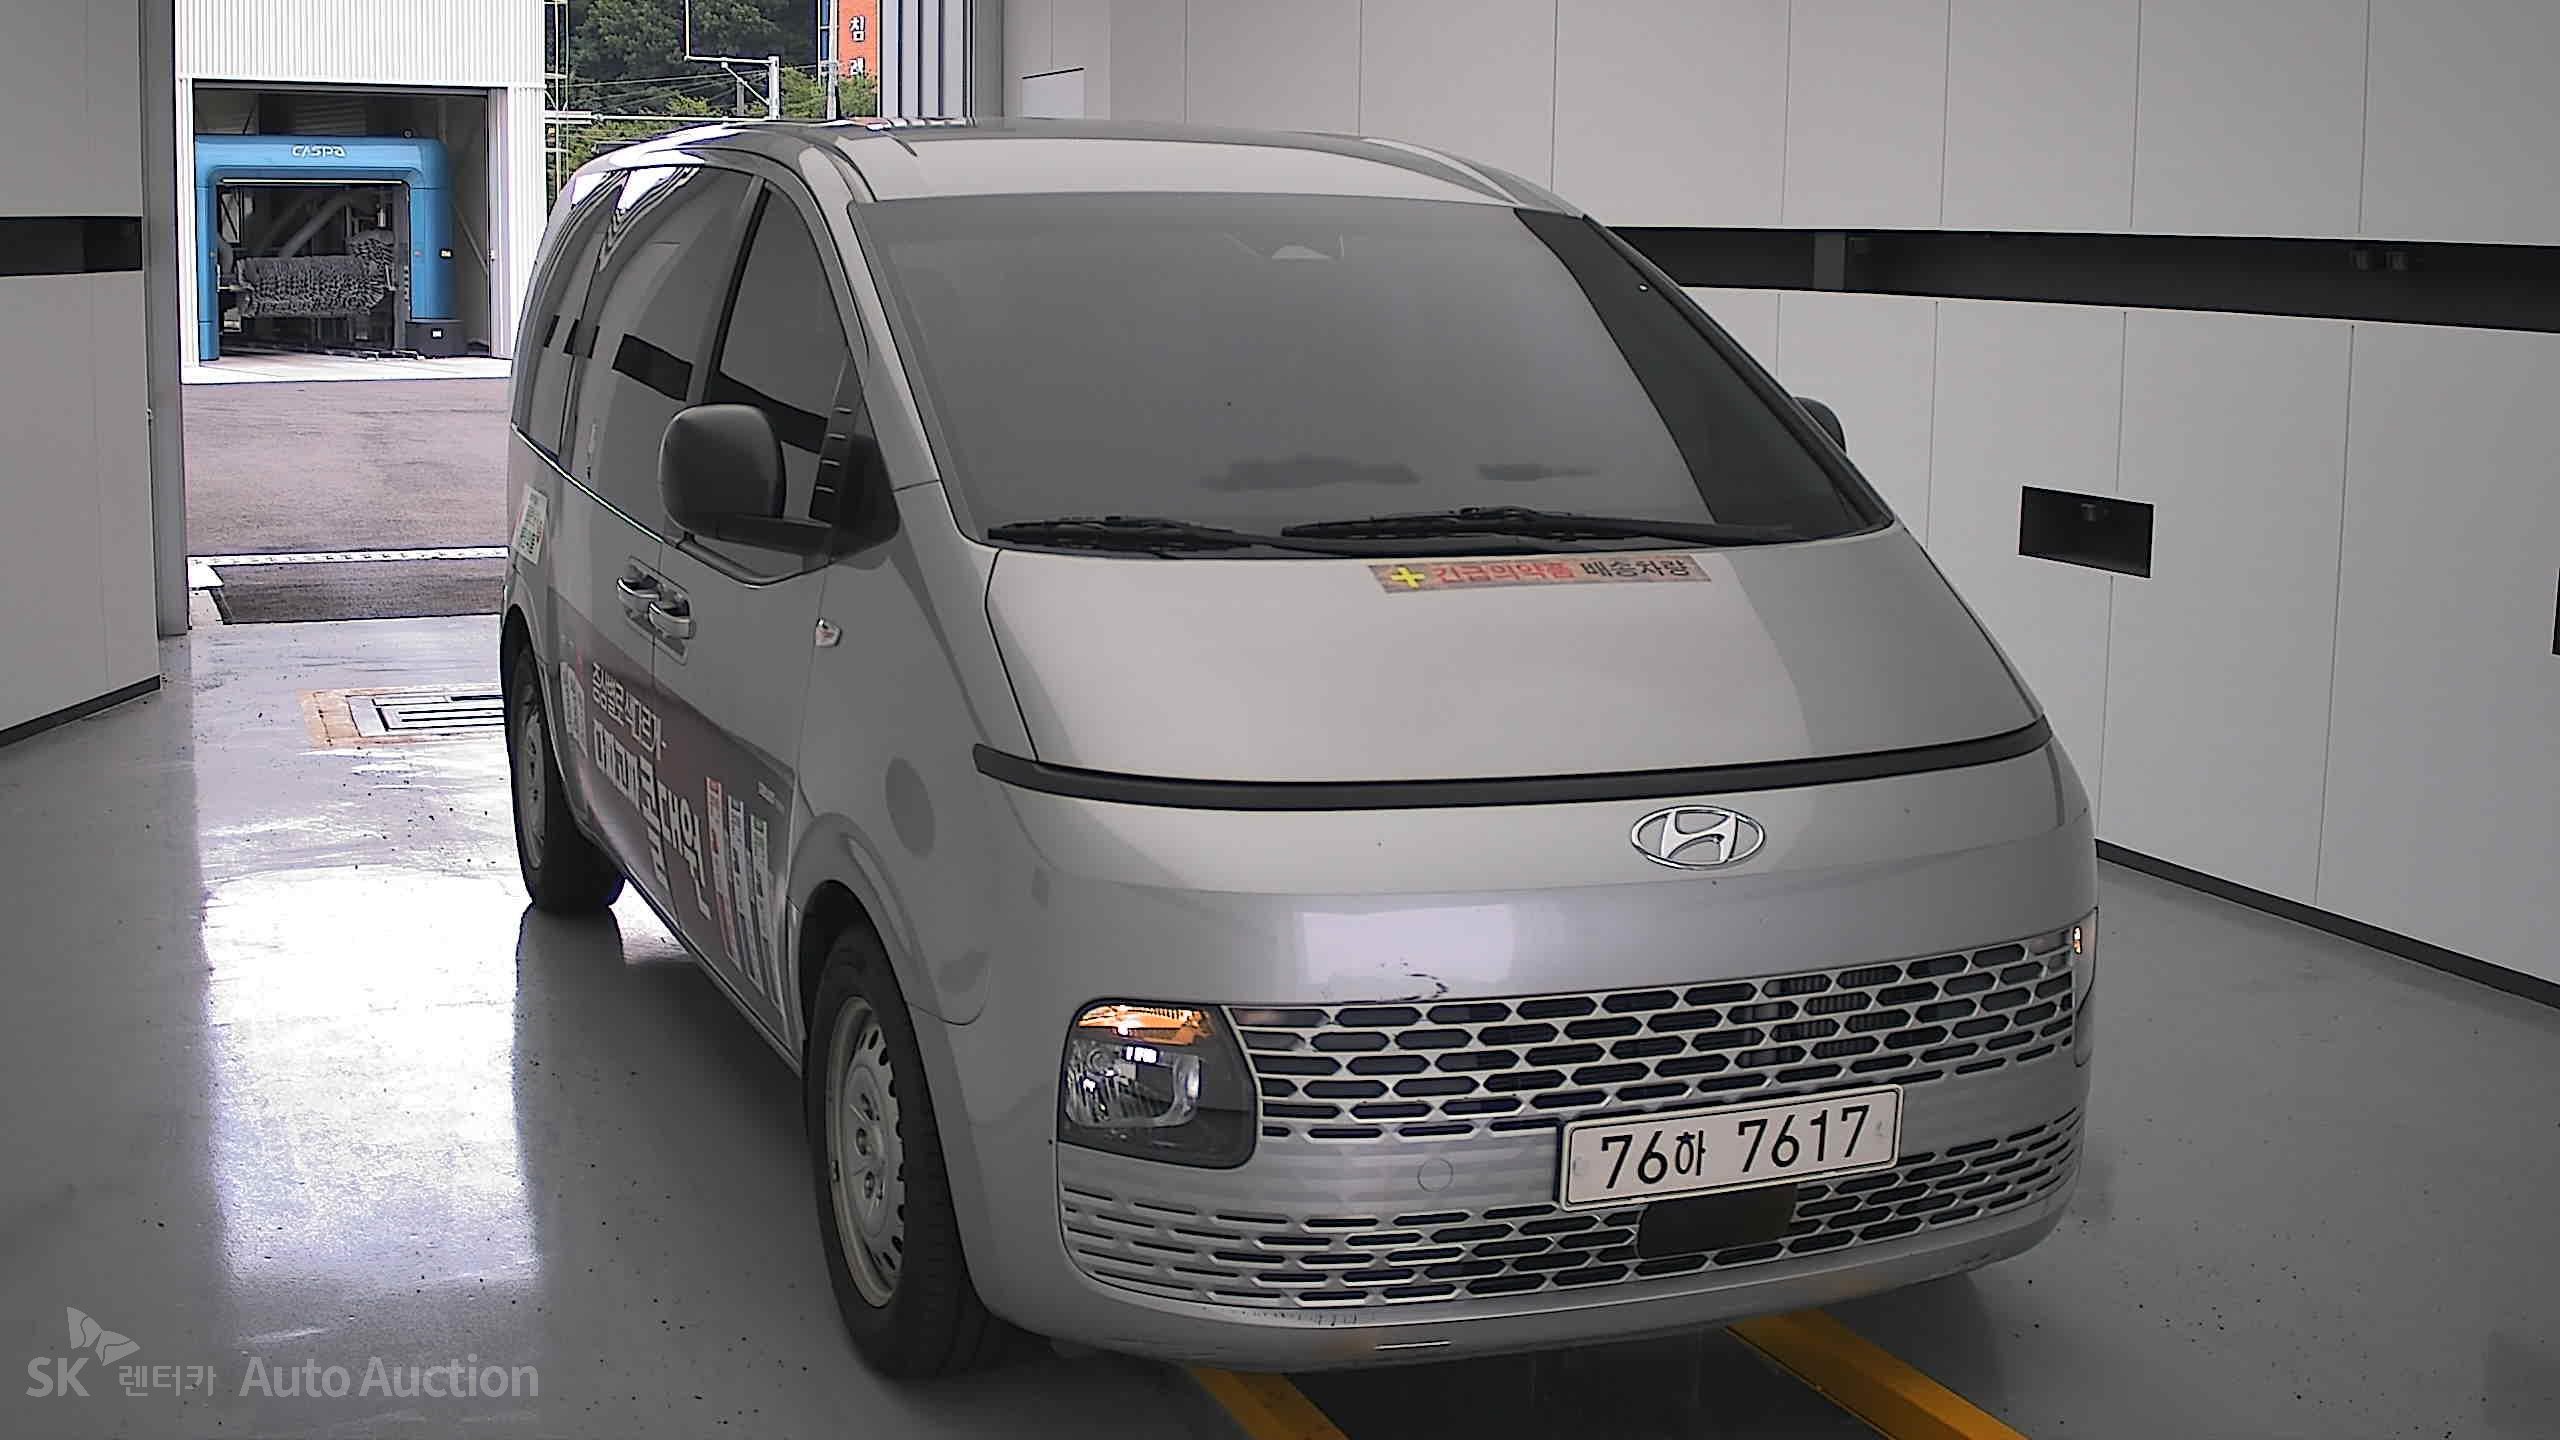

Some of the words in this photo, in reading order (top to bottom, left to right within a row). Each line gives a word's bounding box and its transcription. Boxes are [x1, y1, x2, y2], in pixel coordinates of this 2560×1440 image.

[1580, 559, 1690, 577] 배송차량
[1601, 1129, 1706, 1190] 76하
[1737, 1104, 1870, 1173] 7617
